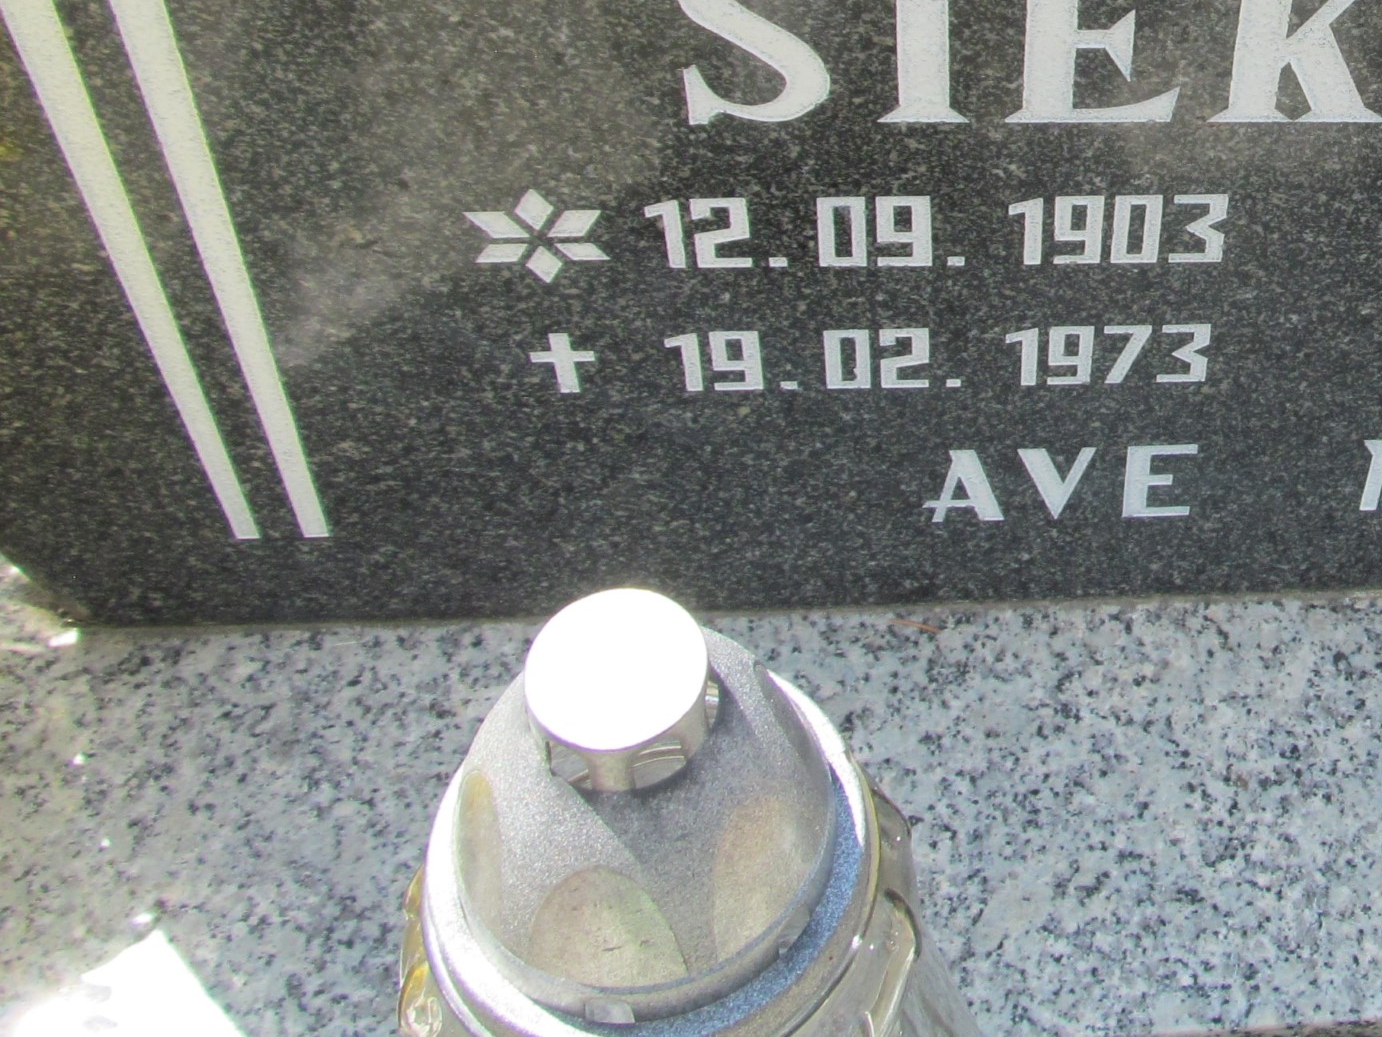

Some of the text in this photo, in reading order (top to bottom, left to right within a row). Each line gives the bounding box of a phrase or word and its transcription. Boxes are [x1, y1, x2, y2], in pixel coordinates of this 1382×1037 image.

[1008, 194, 1230, 266] 1903
[1005, 323, 1212, 386] 1973
[923, 443, 1199, 522] AVE
